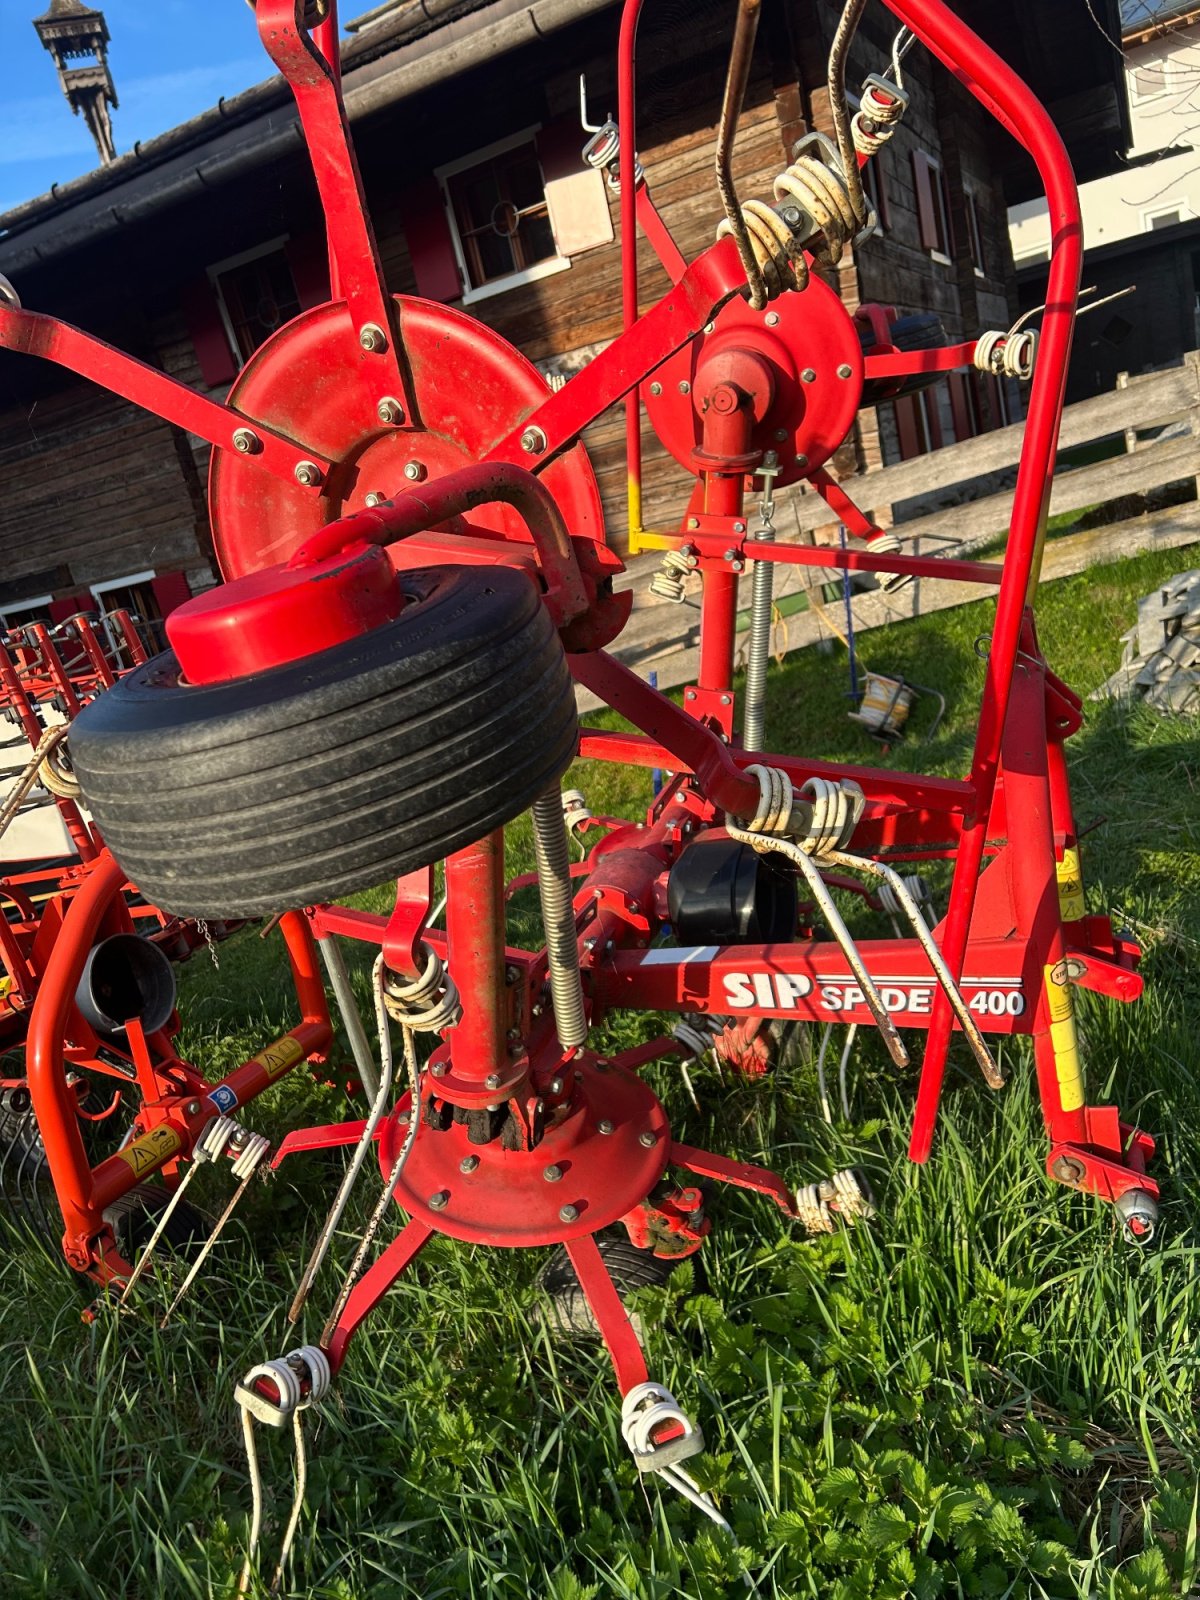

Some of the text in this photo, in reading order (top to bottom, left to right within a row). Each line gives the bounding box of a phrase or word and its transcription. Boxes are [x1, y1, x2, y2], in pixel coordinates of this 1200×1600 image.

[722, 972, 812, 1010] SIP
[820, 985, 932, 1014] SPDE
[968, 990, 1024, 1016] 400
